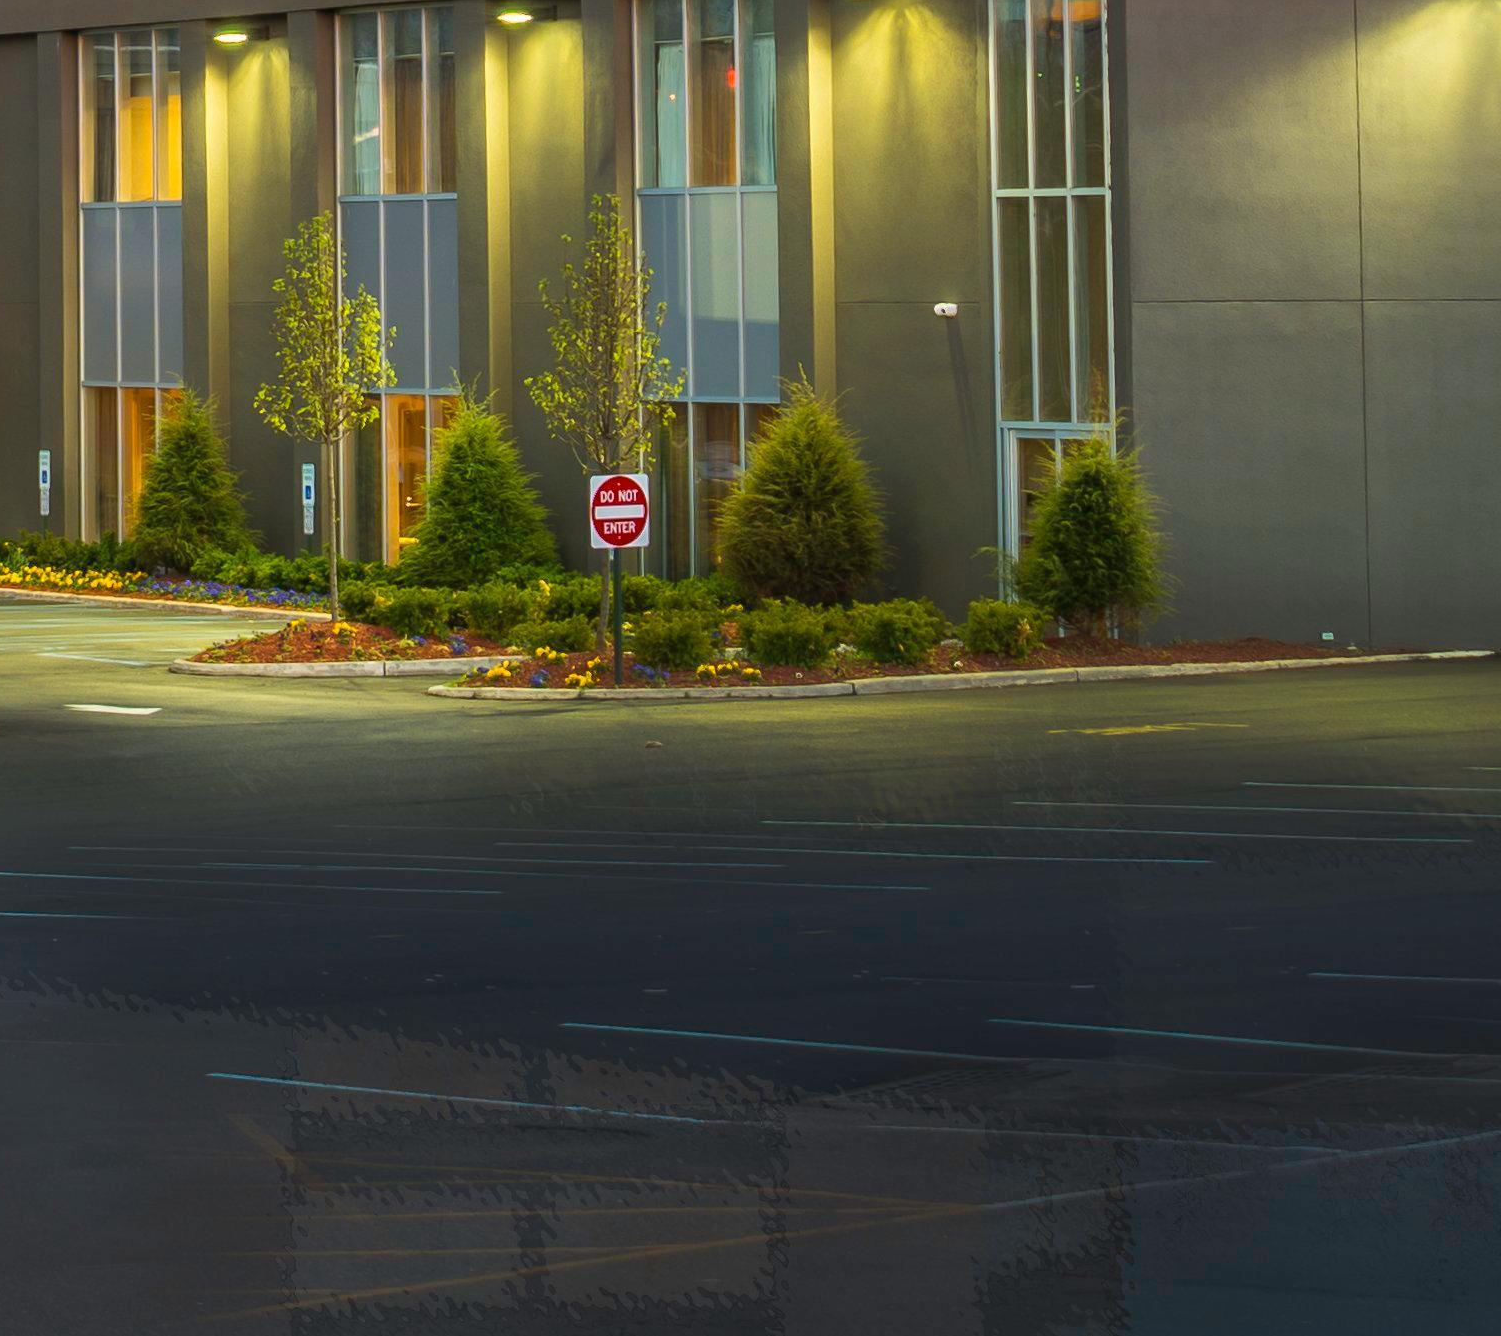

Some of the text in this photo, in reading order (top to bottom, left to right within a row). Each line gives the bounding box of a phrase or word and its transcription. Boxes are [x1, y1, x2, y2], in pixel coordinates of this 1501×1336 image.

[600, 489, 638, 503] DO NOT
[603, 522, 636, 535] ENTER
